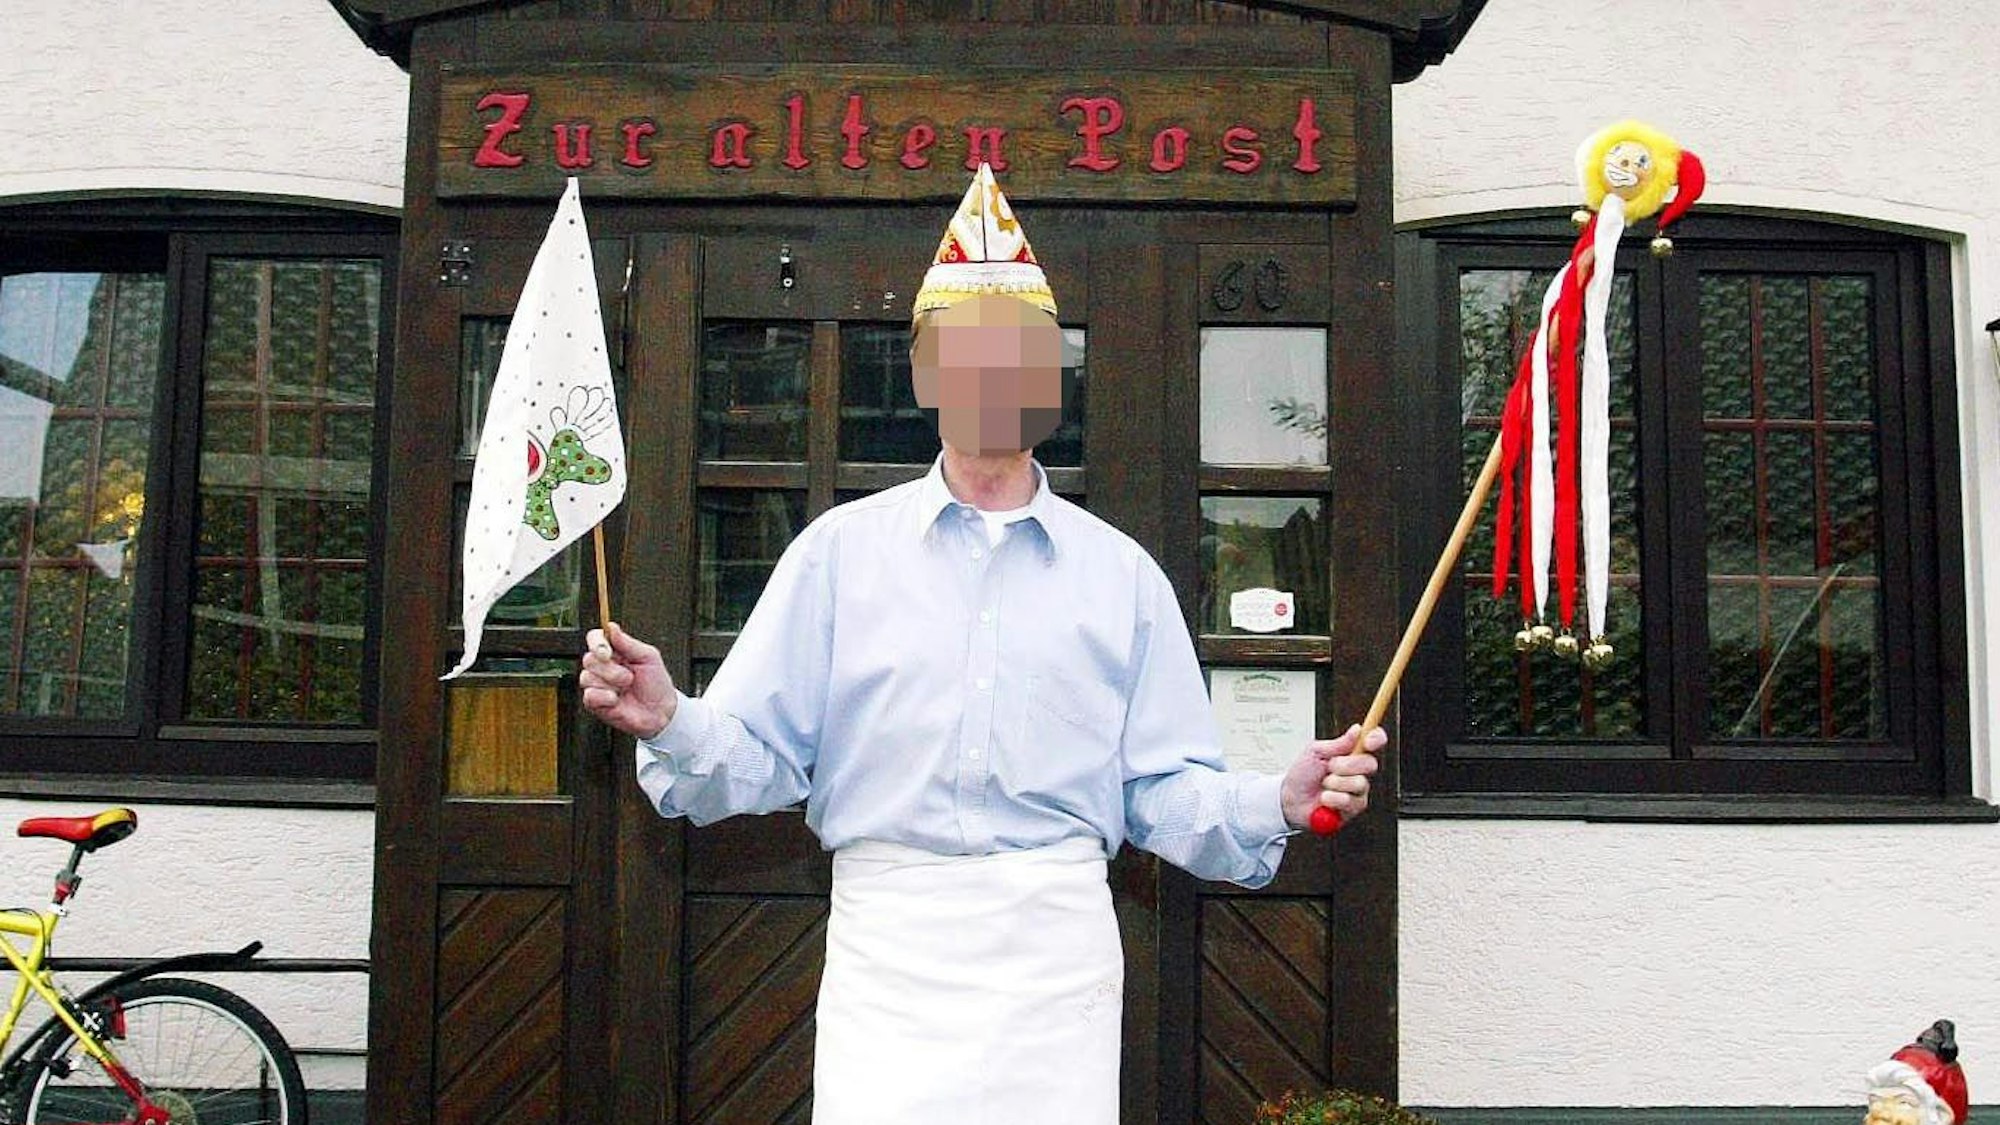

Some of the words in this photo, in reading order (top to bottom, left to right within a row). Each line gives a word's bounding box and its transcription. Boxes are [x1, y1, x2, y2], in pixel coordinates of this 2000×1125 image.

[474, 92, 655, 169] Zur
[710, 95, 1009, 171] alten
[1060, 97, 1322, 172] Post
[1213, 259, 1287, 312] 60
